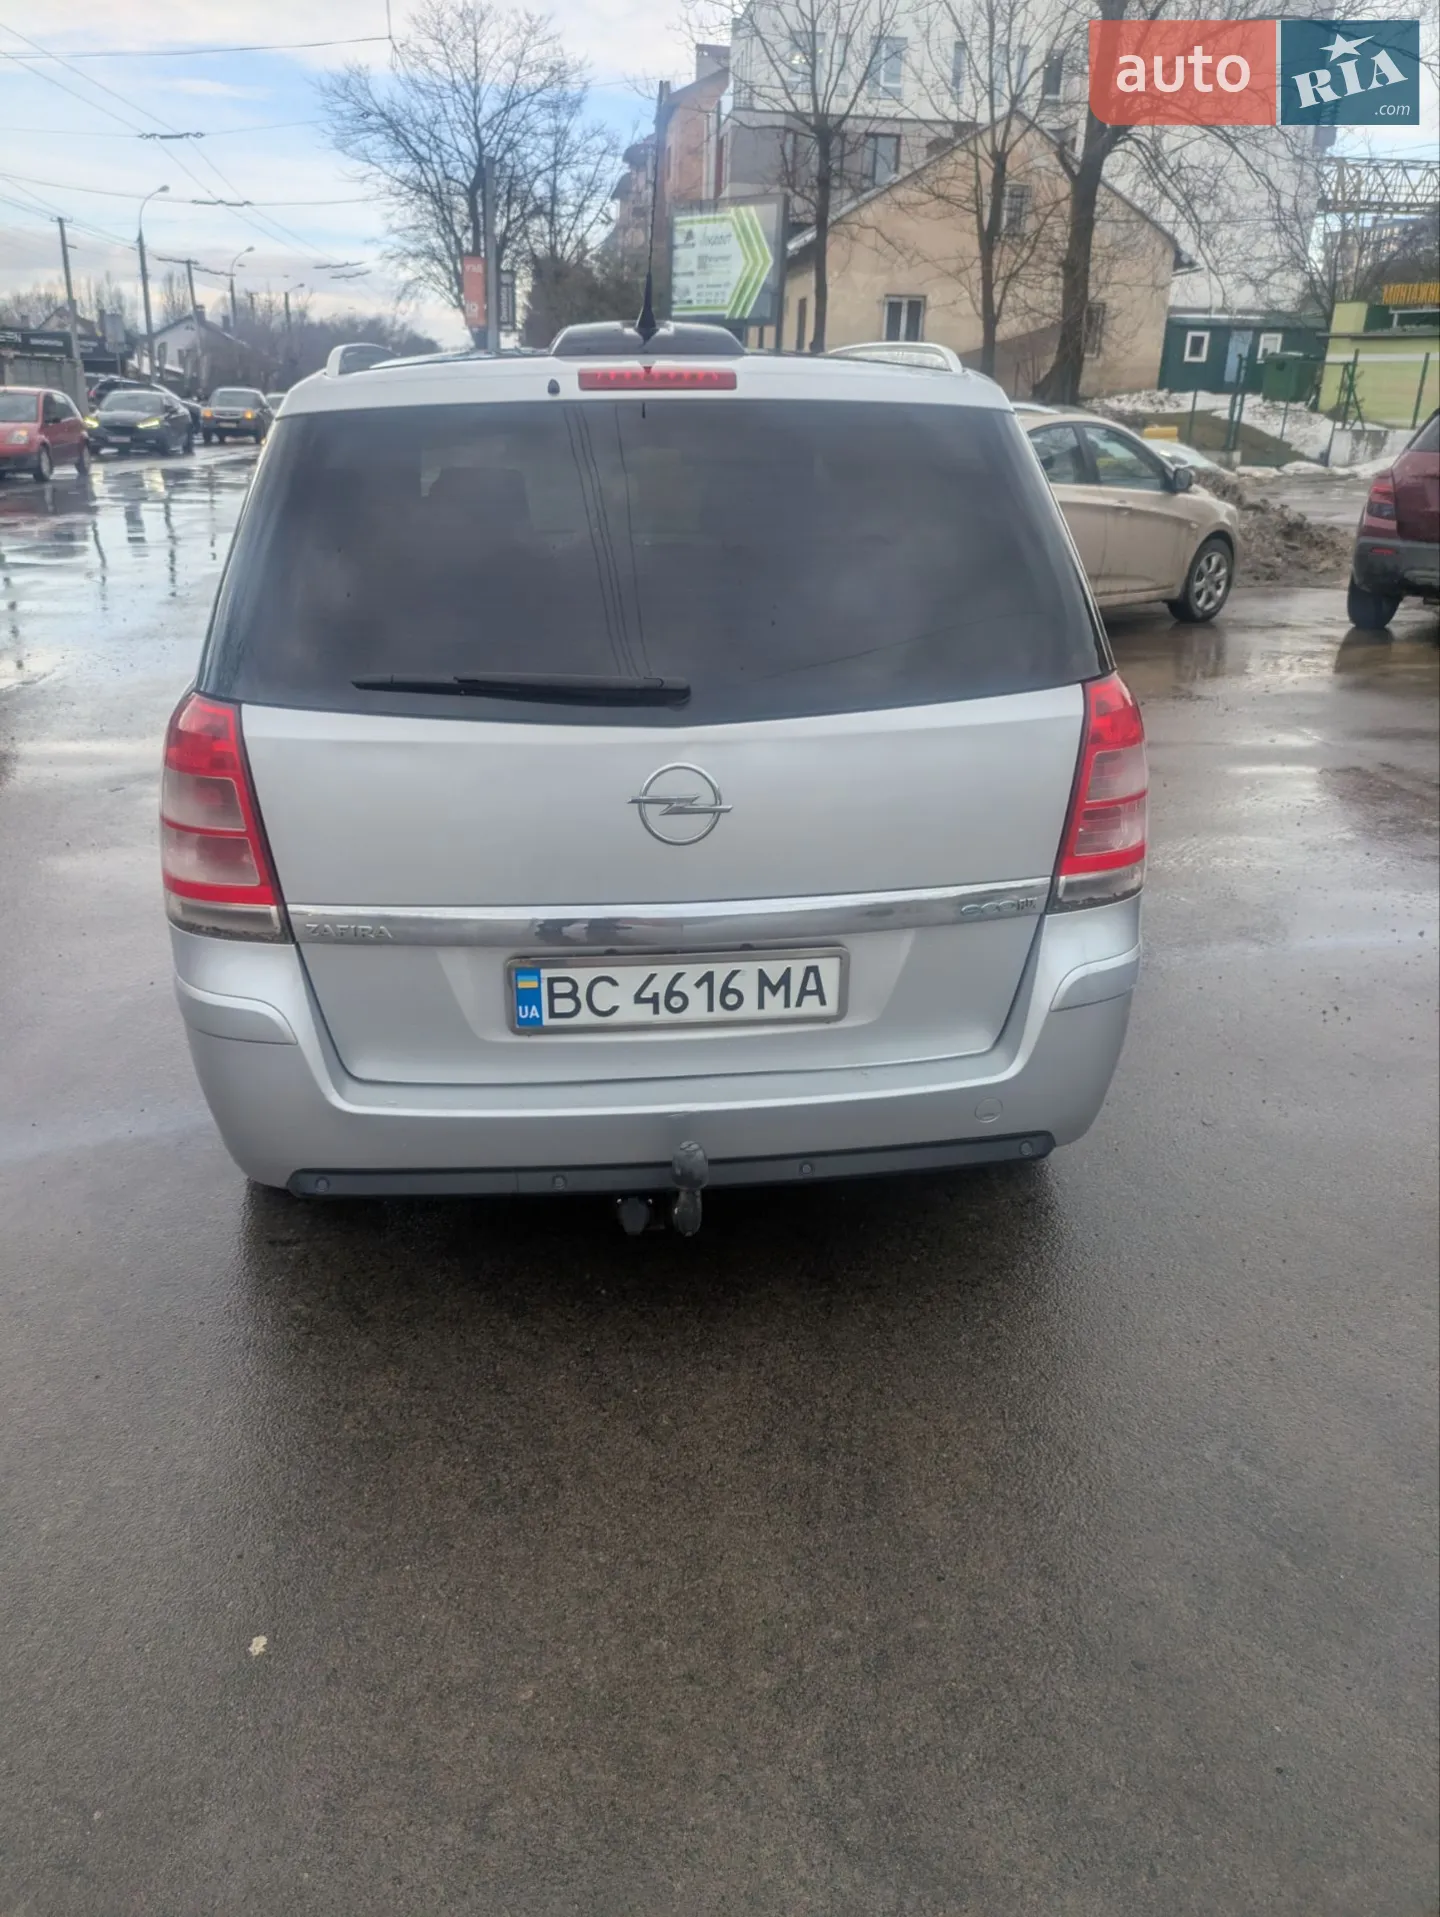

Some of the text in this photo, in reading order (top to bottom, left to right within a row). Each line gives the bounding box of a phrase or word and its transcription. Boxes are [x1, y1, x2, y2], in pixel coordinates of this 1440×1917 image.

[1383, 283, 1440, 304] МОНТАЖН
[305, 923, 393, 939] ZAFIRA
[546, 965, 827, 1019] BC 4616 MA
[518, 1005, 540, 1019] UA
